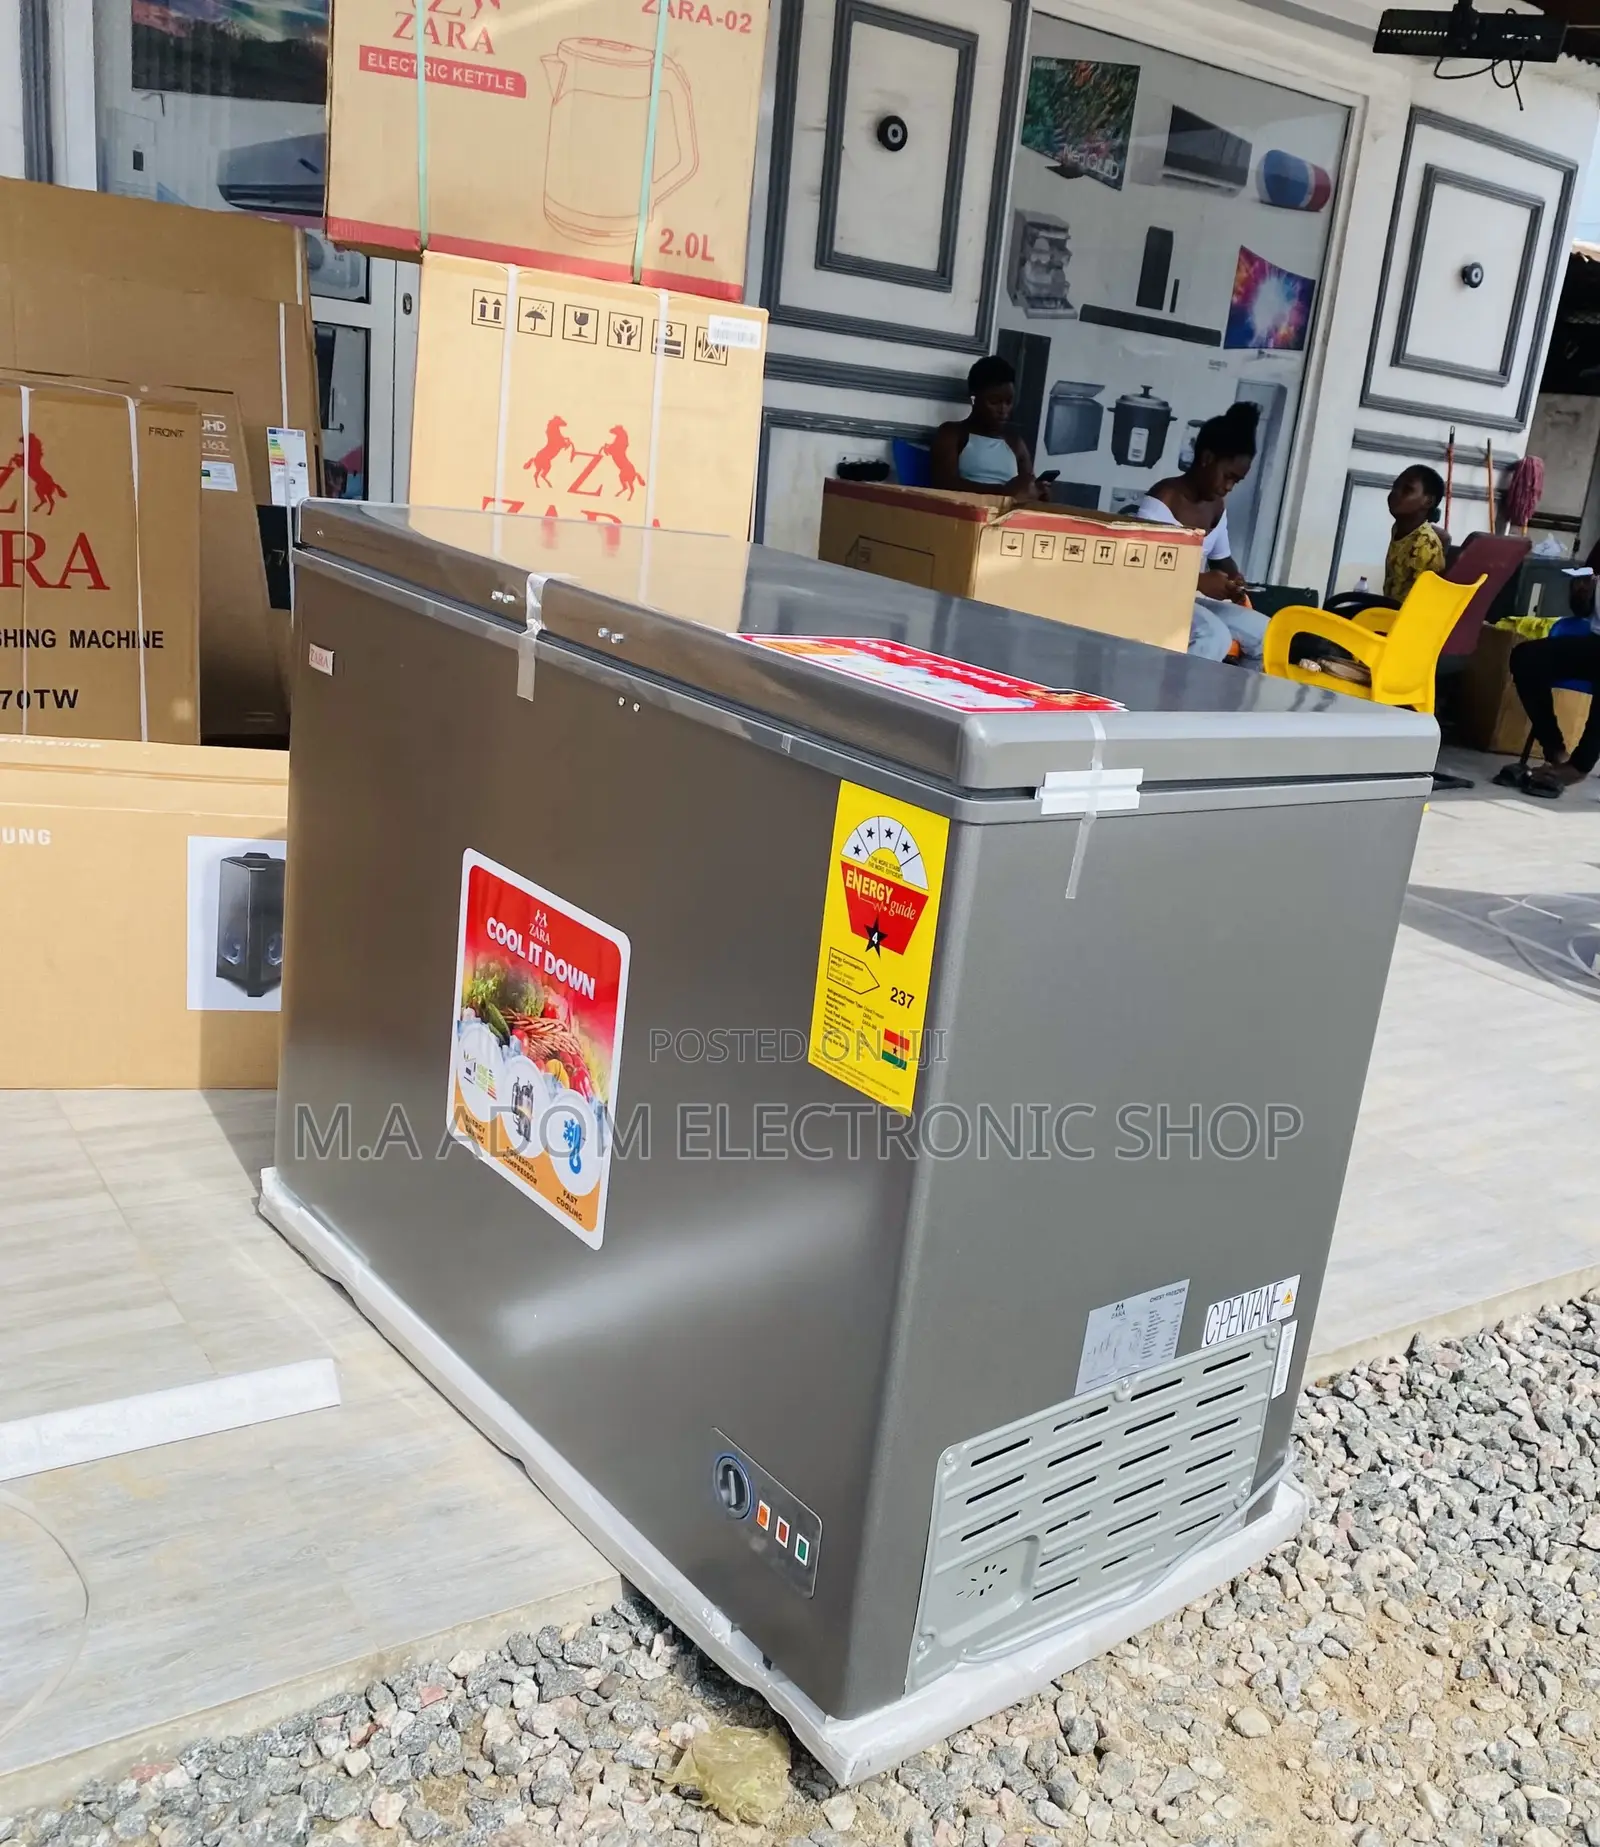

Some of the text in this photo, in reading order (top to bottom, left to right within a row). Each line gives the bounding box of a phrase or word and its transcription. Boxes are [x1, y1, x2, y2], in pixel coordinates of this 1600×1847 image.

[392, 11, 496, 55] ZARA
[367, 52, 516, 92] ELECTRIC KETTLE
[659, 227, 715, 262] 2.0L
[148, 426, 185, 438] FRONT
[567, 451, 604, 497] Z
[0, 529, 111, 591] RA
[0, 628, 164, 649] HING MACHINE
[310, 648, 330, 669] ZARA
[0, 688, 79, 710] 70TW
[1, 826, 52, 846] UNG
[845, 867, 894, 905] ENERGY
[888, 900, 917, 921] guide
[528, 923, 551, 946] ZARA
[872, 931, 879, 945] 4
[486, 916, 596, 1001] COOL IT DOWN
[890, 986, 915, 1010] 237
[502, 1154, 538, 1186] COMPRESSOR
[556, 1196, 583, 1222] COOLING
[562, 1189, 579, 1206] FAST
